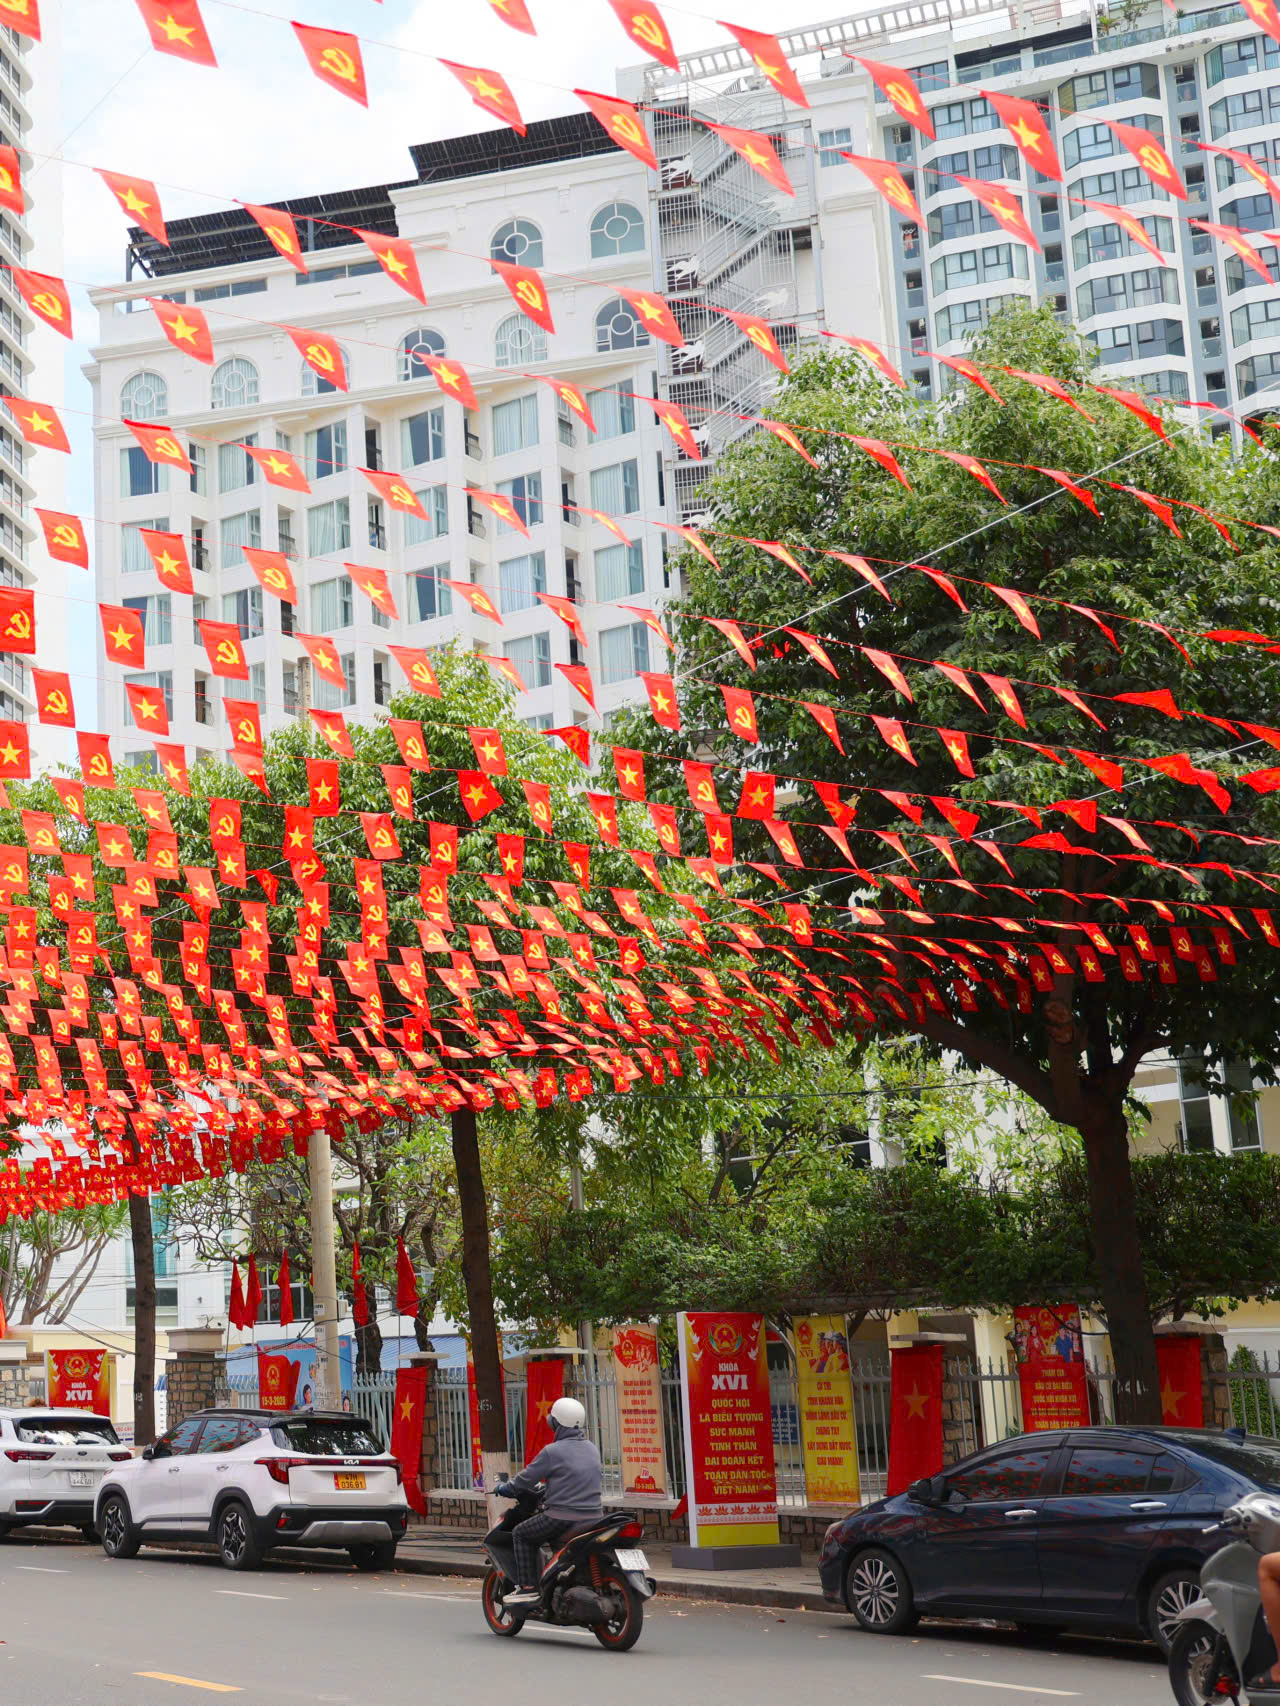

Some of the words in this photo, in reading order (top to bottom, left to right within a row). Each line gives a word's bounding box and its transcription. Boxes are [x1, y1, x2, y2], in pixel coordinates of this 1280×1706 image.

[718, 1361, 739, 1372] KHÓA
[711, 1374, 749, 1390] XVI
[66, 1390, 93, 1401] XVI
[711, 1398, 734, 1409] QUỐC
[735, 1398, 751, 1408] HỘI
[709, 1442, 731, 1451] TINH
[733, 1440, 757, 1451] THẦN
[747, 1452, 764, 1465] KẾT
[713, 1484, 733, 1495] VIỆT
